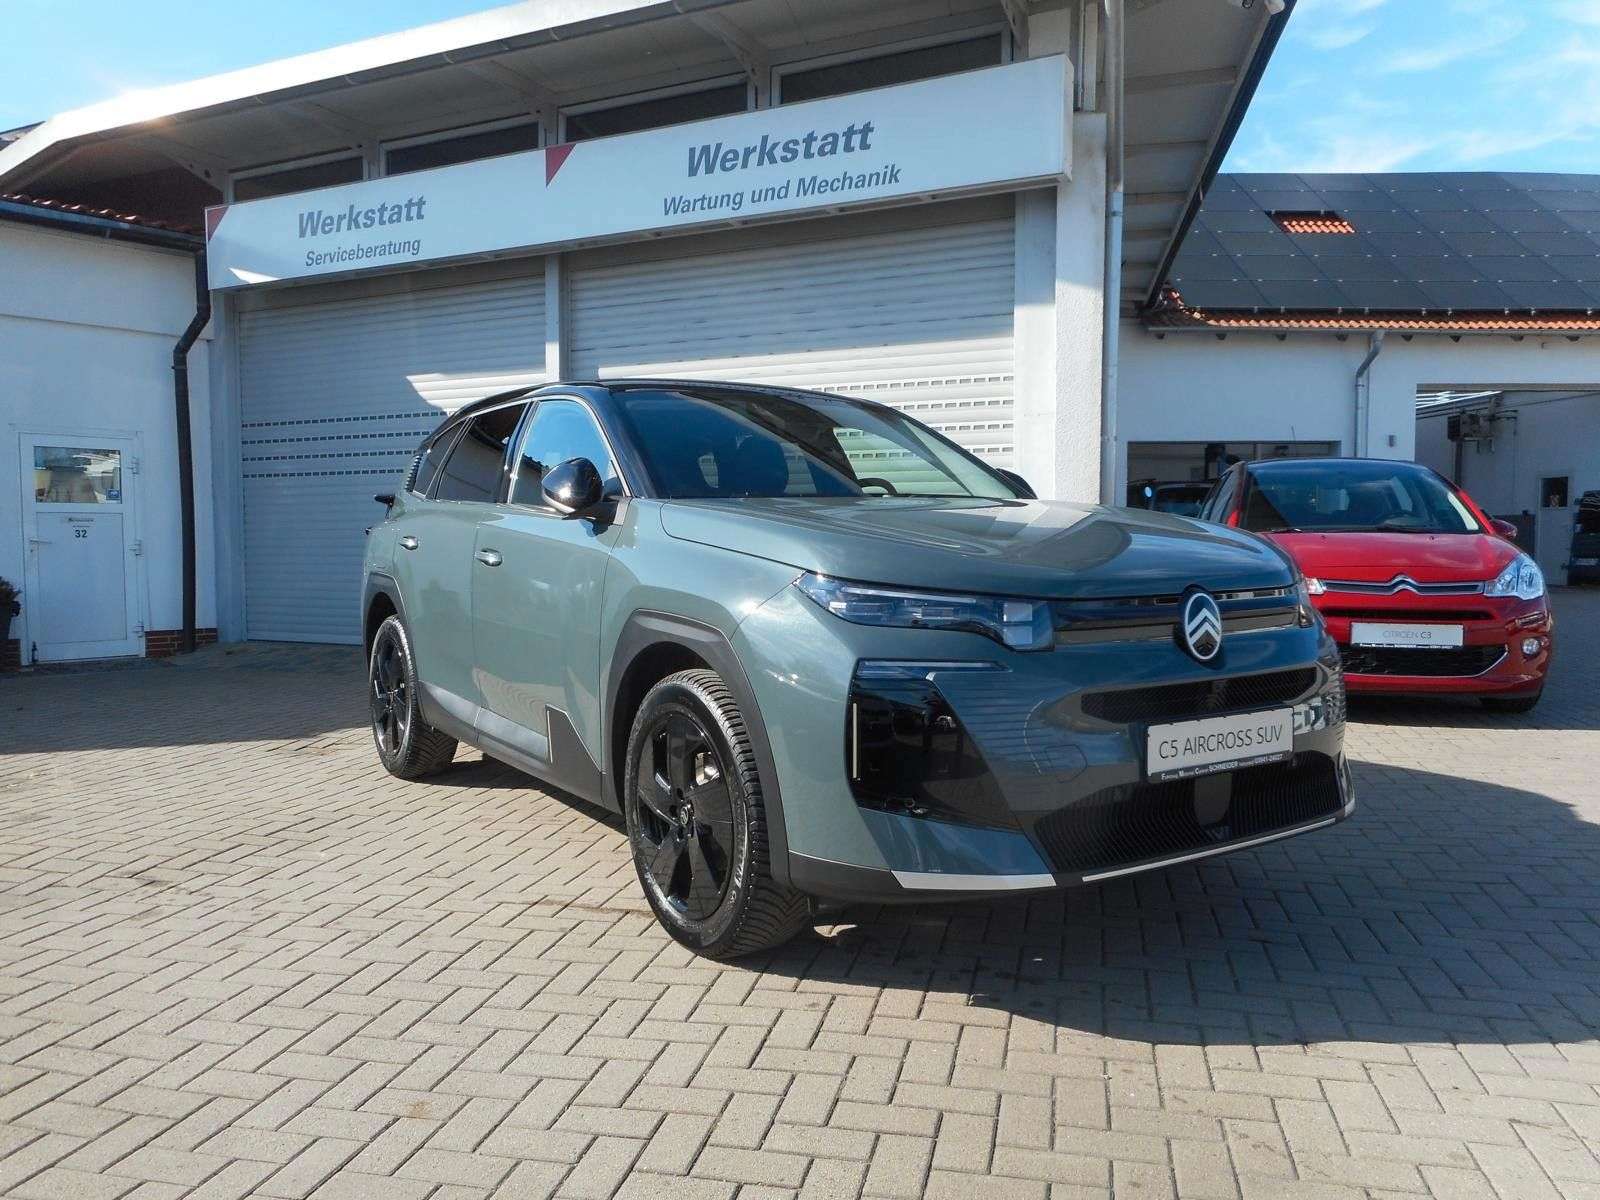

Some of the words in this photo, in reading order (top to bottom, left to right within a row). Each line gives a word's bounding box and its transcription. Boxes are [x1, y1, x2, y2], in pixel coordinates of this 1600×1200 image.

[687, 120, 874, 177] Werkstatt
[663, 191, 744, 216] Wartung
[751, 180, 790, 203] und
[796, 163, 901, 198] Mechanik
[298, 195, 426, 239] Werkstatt
[305, 239, 421, 267] Serviceberatung
[75, 529, 88, 538] 32
[1420, 631, 1432, 640] C3
[1159, 740, 1178, 759] C5
[1183, 729, 1252, 756] AIRCROSS
[1256, 725, 1282, 744] SUV
